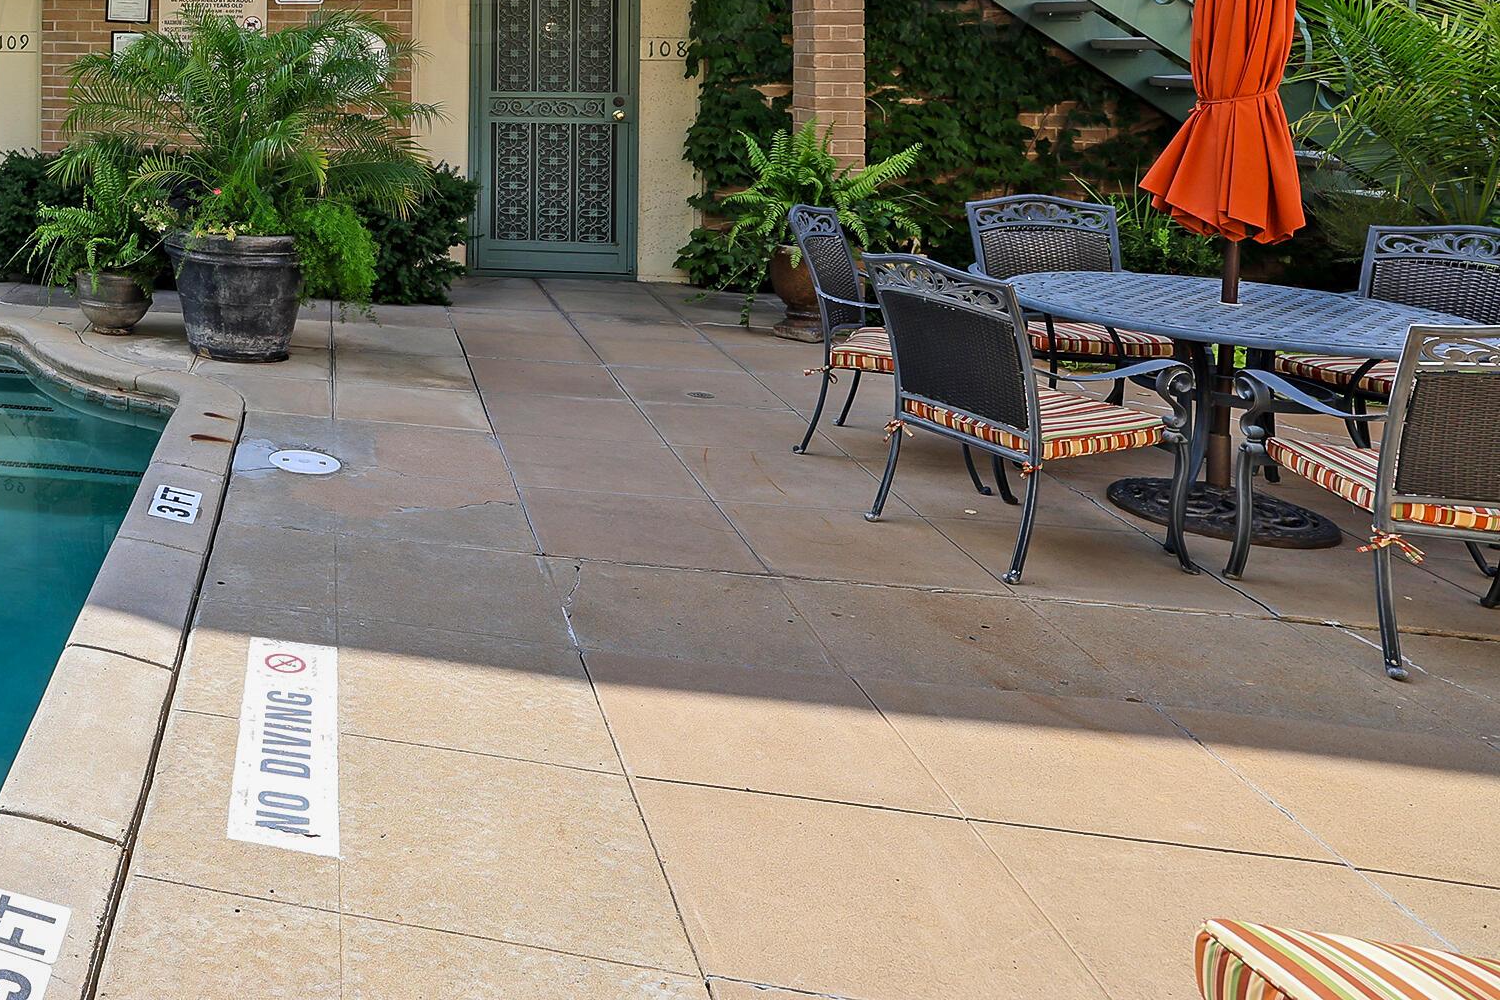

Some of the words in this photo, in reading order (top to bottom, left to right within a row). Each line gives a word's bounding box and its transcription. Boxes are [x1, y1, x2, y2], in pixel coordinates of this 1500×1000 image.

[649, 40, 687, 57] 108
[259, 690, 313, 780] DIVING
[255, 789, 310, 834] NO
